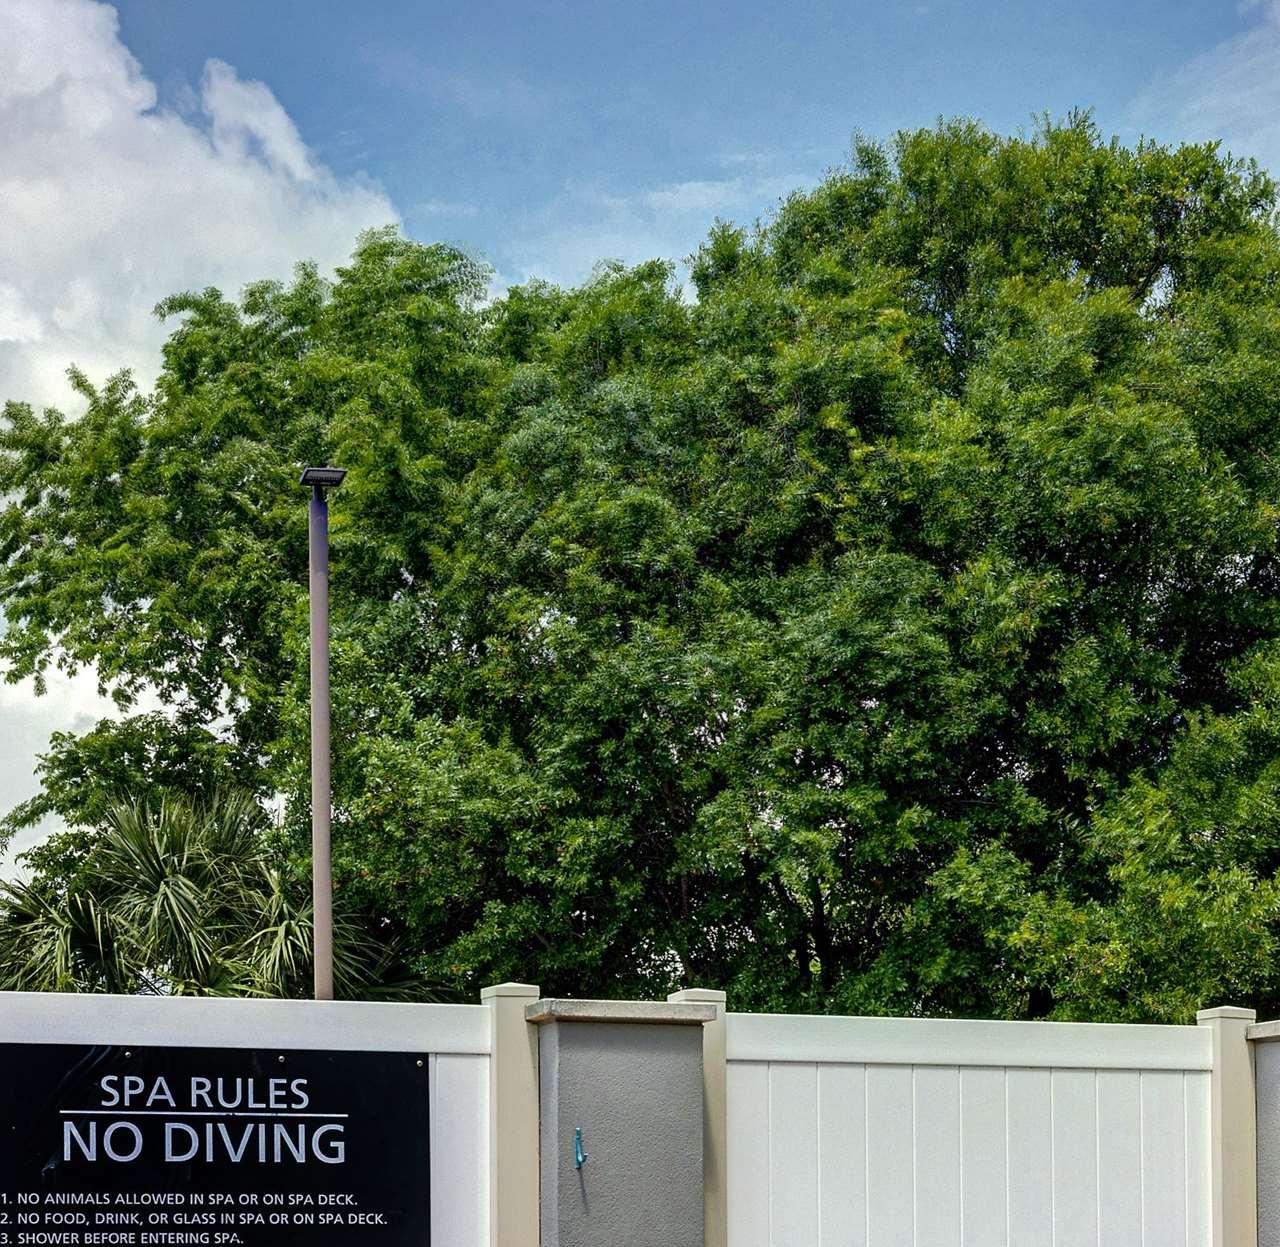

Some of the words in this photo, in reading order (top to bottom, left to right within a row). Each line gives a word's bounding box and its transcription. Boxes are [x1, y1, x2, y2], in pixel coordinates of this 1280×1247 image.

[100, 1075, 177, 1107] SPA
[191, 1076, 309, 1110] RULES
[63, 1121, 143, 1162] NO
[164, 1122, 345, 1164] DIVING
[1, 1192, 13, 1205] 1.
[17, 1192, 40, 1205] NO
[44, 1192, 111, 1205] ANIMALS
[114, 1193, 185, 1205] ALLOWED
[189, 1193, 204, 1205] IN
[208, 1193, 235, 1205] SPA
[238, 1193, 259, 1205] OR
[262, 1193, 284, 1206] ON
[288, 1193, 314, 1206] SPA
[318, 1193, 358, 1206] DECK.
[0, 1212, 13, 1225] 2.
[17, 1212, 40, 1225] NO
[44, 1212, 90, 1226] FOOD,
[95, 1212, 144, 1226] DRINK,
[148, 1212, 169, 1225] OR
[172, 1212, 217, 1225] GLASS
[220, 1212, 235, 1225] IN
[239, 1212, 265, 1225] SPA
[269, 1213, 289, 1225] OR
[293, 1213, 314, 1225] ON
[318, 1213, 345, 1225] SPA
[348, 1213, 388, 1225] DECK.
[0, 1232, 13, 1245] 3.
[17, 1232, 80, 1245] SHOWER
[84, 1232, 136, 1245] BEFORE
[140, 1232, 210, 1244] ENTERING
[214, 1232, 244, 1244] SPA.
